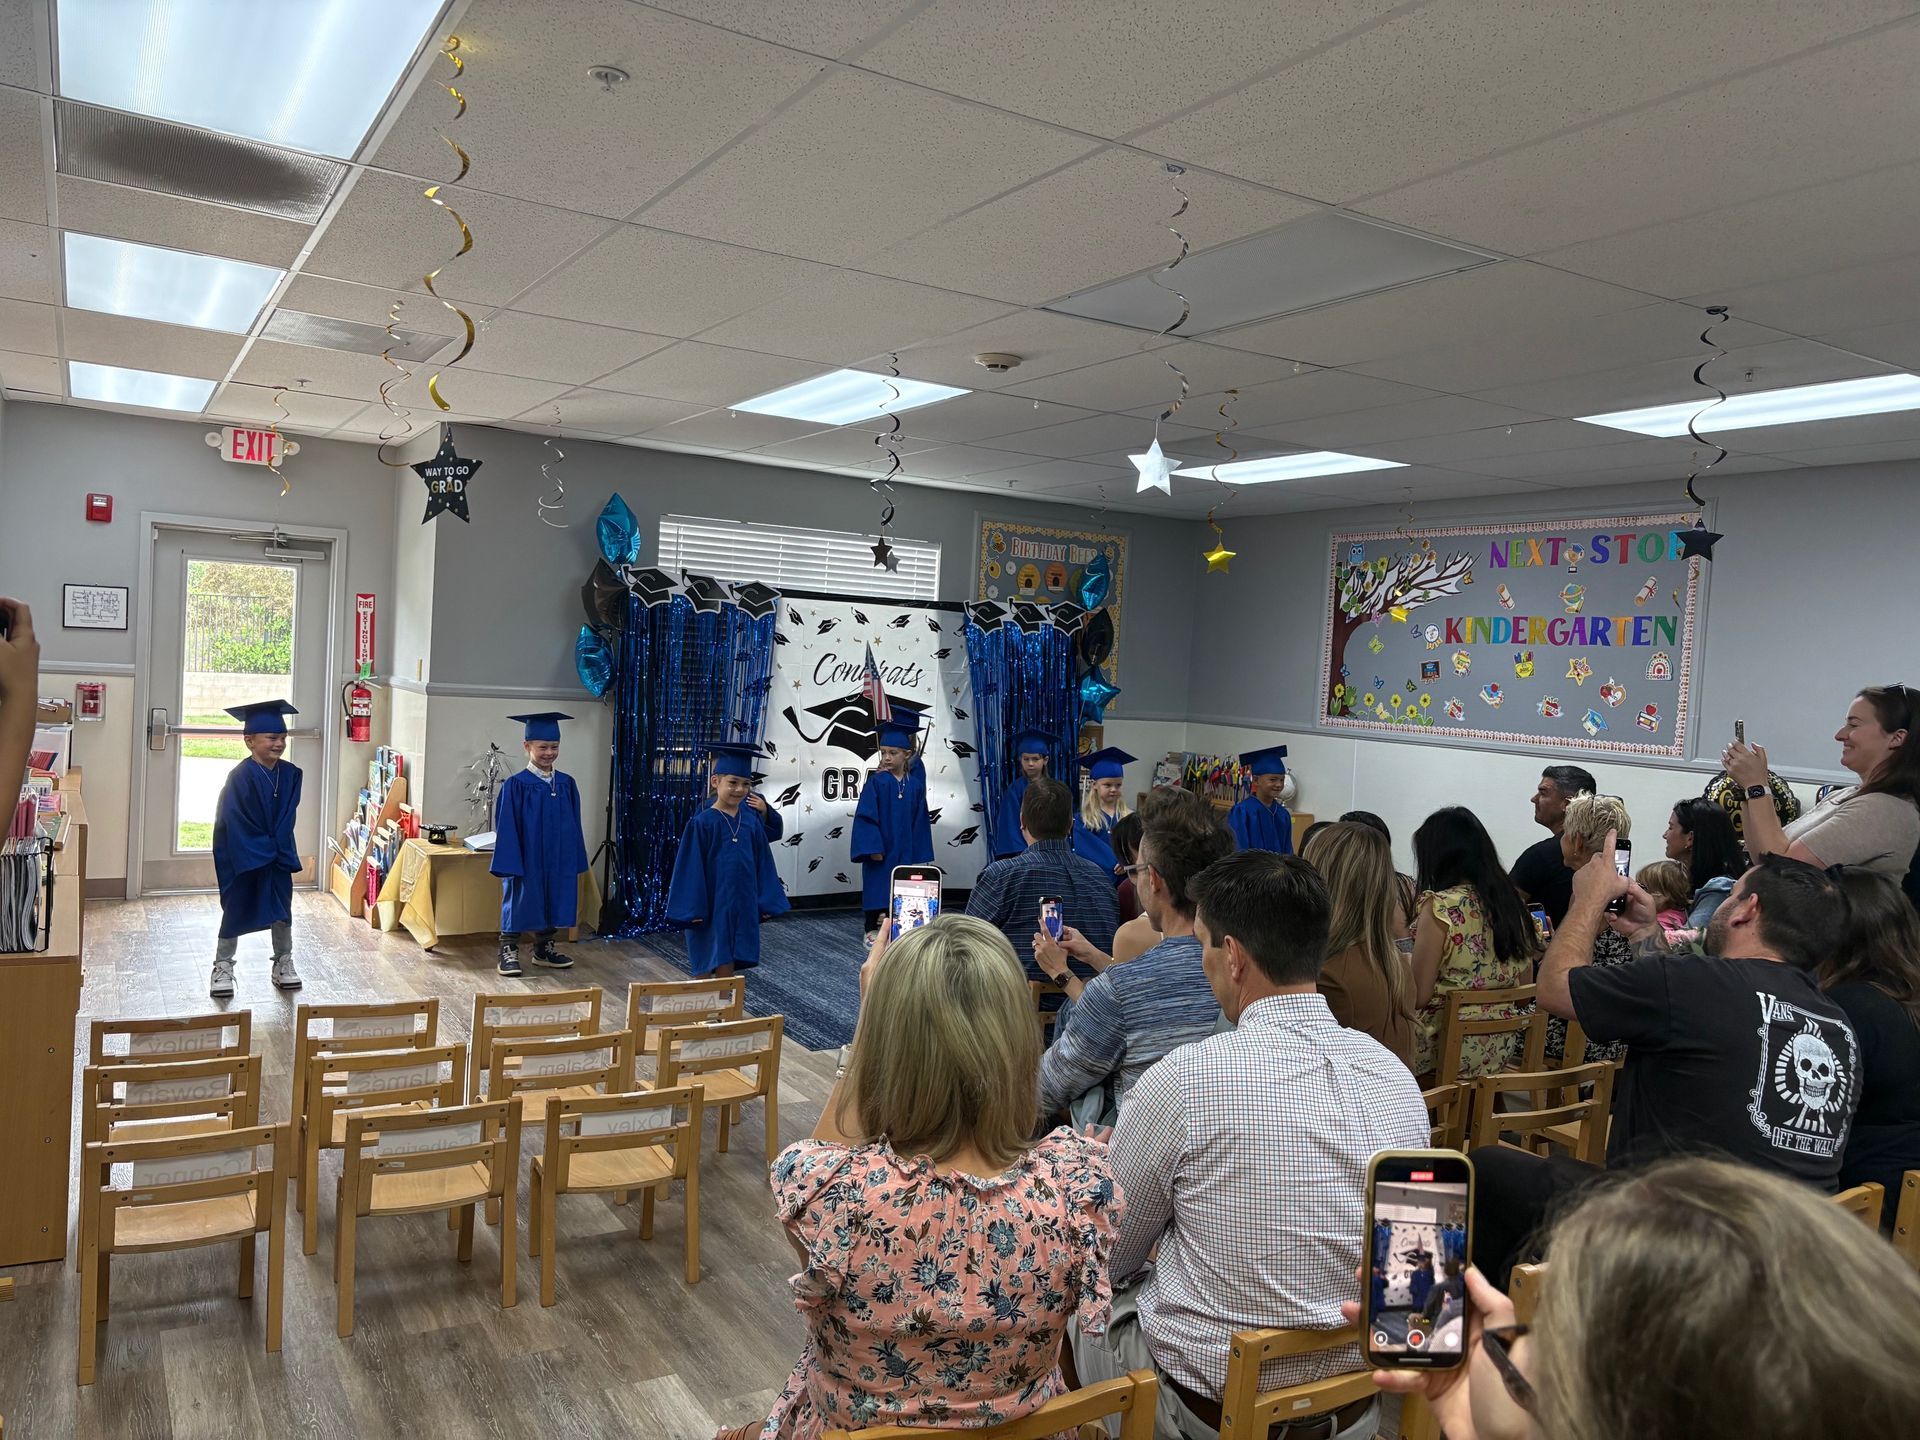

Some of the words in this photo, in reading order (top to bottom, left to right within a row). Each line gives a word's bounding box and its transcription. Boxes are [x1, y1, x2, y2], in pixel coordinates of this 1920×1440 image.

[232, 429, 276, 462] EXIT
[425, 467, 442, 477] WAY
[444, 466, 455, 476] TO
[456, 465, 469, 475] GO
[431, 480, 463, 493] GRAD
[1011, 538, 1067, 561] BIRTHDAY
[1069, 544, 1098, 564] BEES
[1490, 537, 1567, 568] NEXT
[358, 600, 373, 609] FIRE
[361, 611, 369, 665] EXTINGUISHE
[1445, 615, 1678, 647] KINDERGARTEN
[1756, 992, 1794, 1024] VANS
[1772, 1126, 1794, 1148] OFF
[1795, 1133, 1811, 1151] THE
